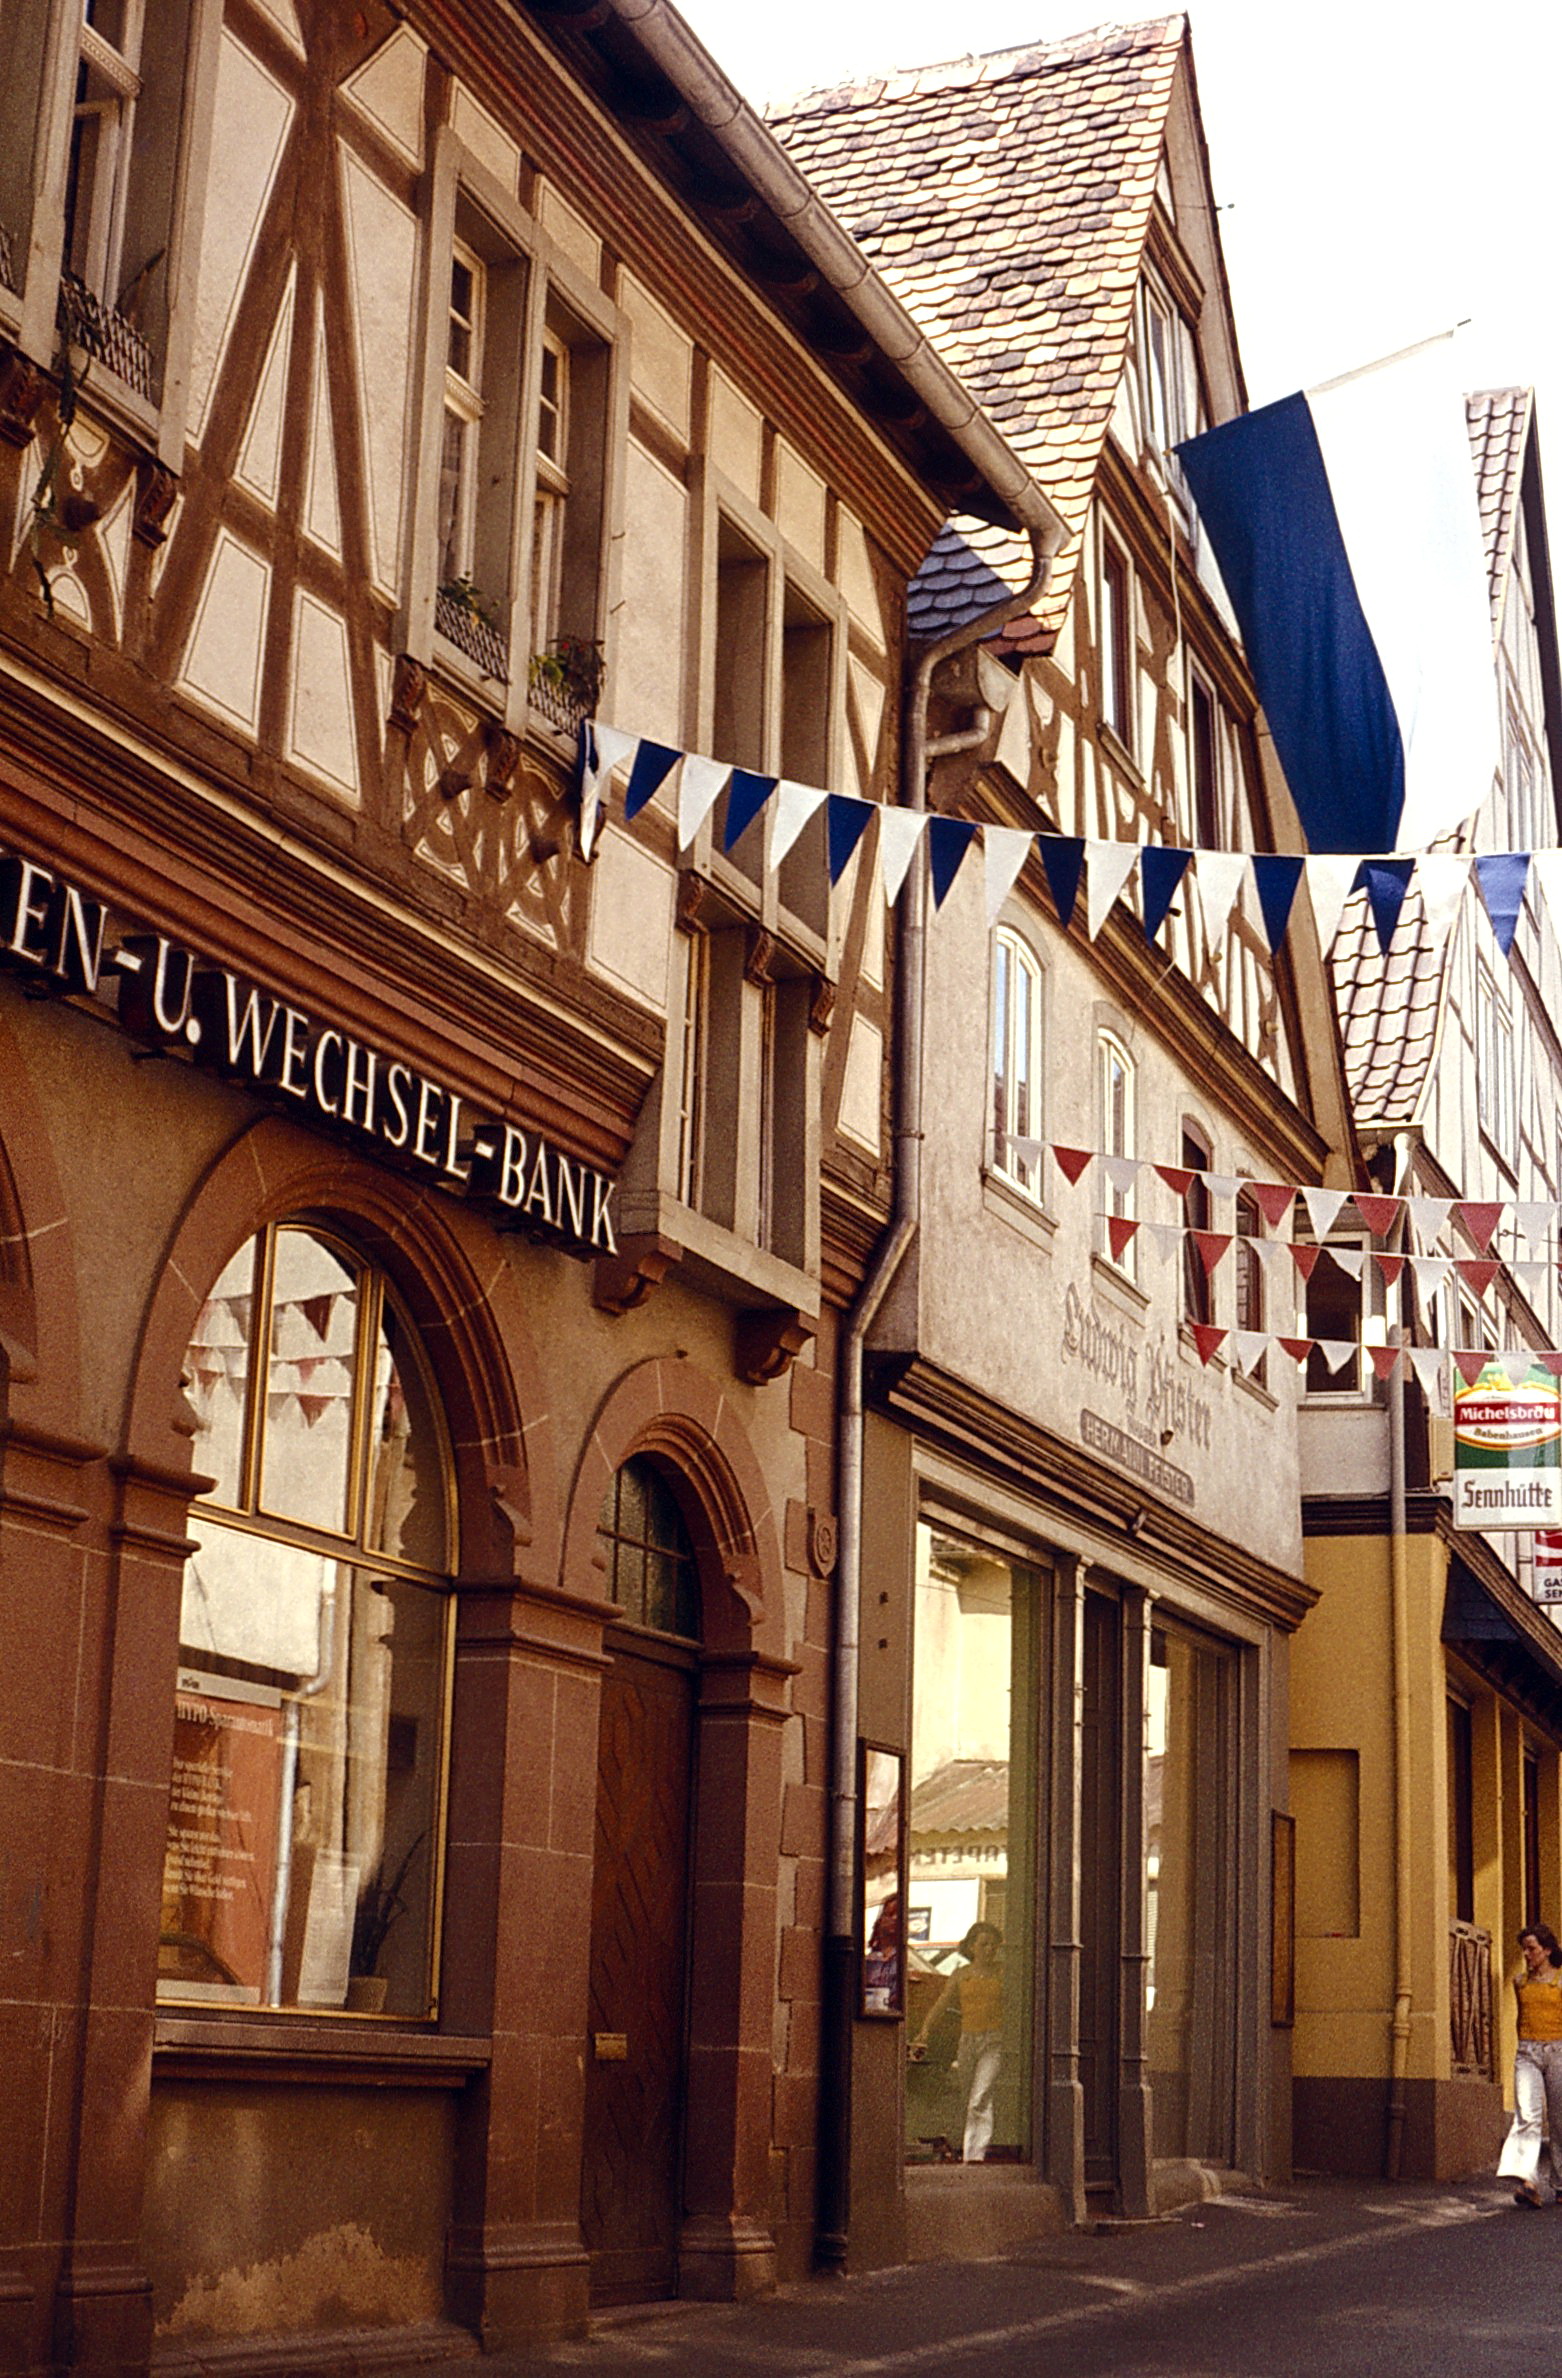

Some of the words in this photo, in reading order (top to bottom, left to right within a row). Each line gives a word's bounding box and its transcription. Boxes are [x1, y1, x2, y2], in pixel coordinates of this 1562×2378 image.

[224, 971, 618, 1255] WECHSEL-BANK
[1460, 1405, 1555, 1420] Michelsbräu
[1474, 1427, 1543, 1439] Babenhausen
[1460, 1480, 1553, 1508] Sennhütte
